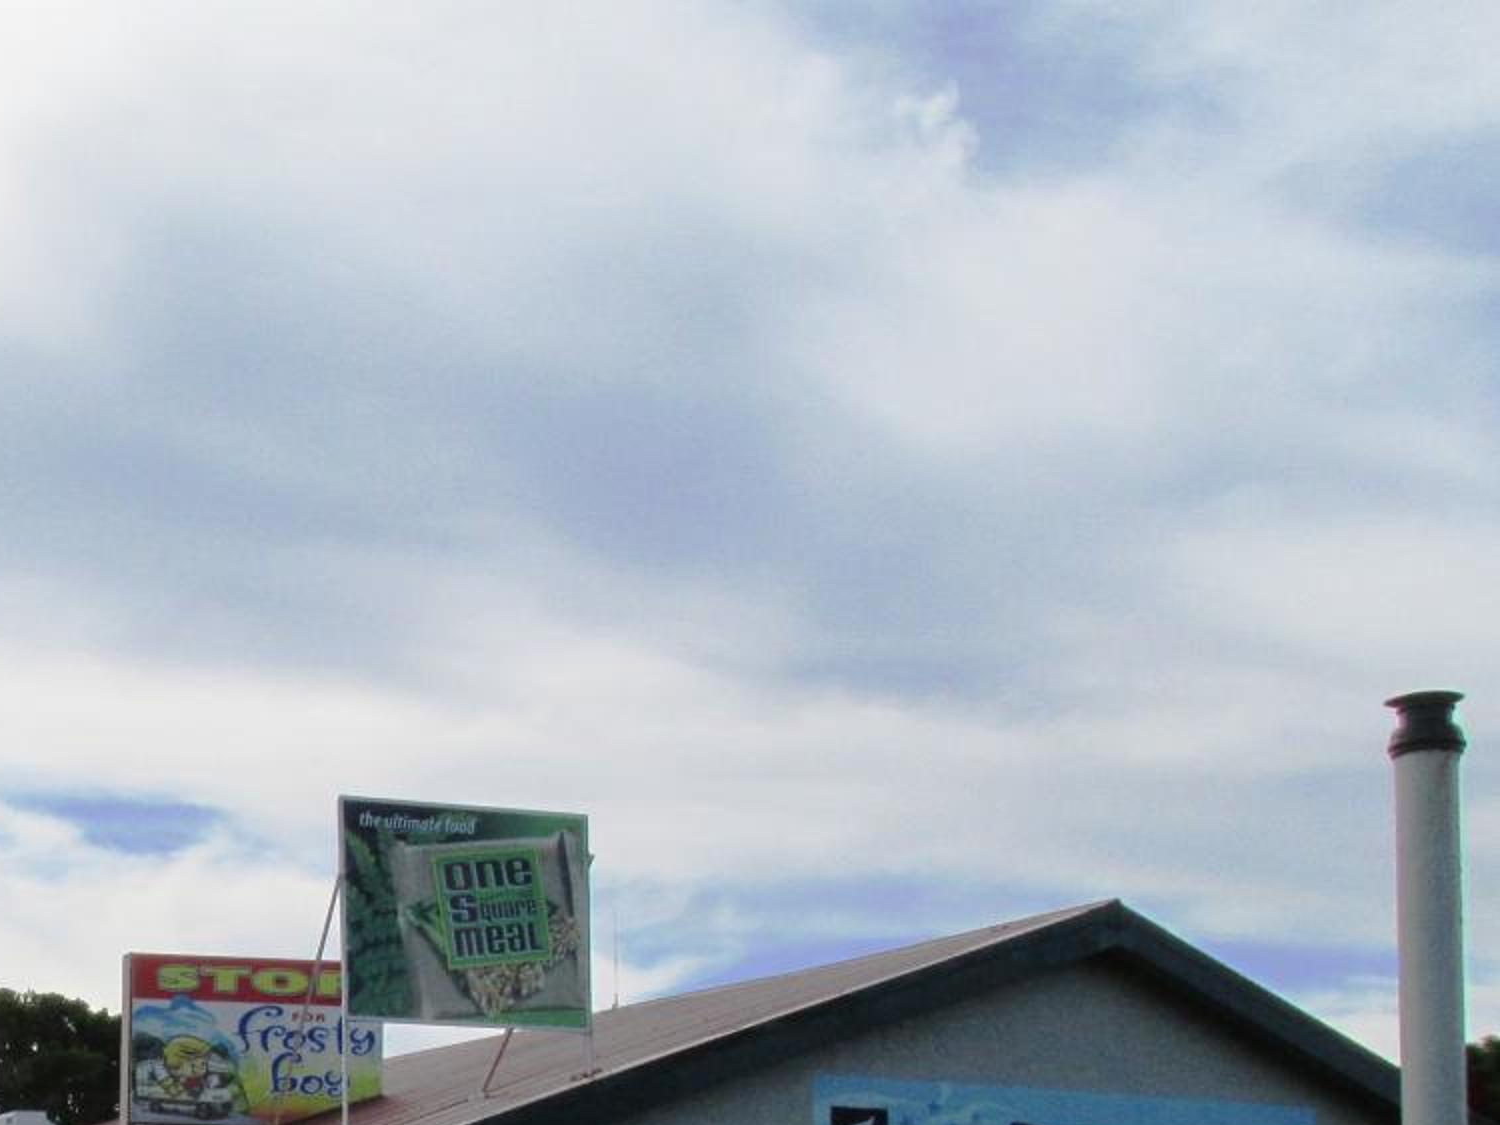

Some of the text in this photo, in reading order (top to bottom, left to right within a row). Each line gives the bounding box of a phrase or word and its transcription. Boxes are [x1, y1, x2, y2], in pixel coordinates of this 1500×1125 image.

[359, 810, 477, 834] the ultimate food
[444, 858, 533, 890] one
[453, 921, 544, 957] meal
